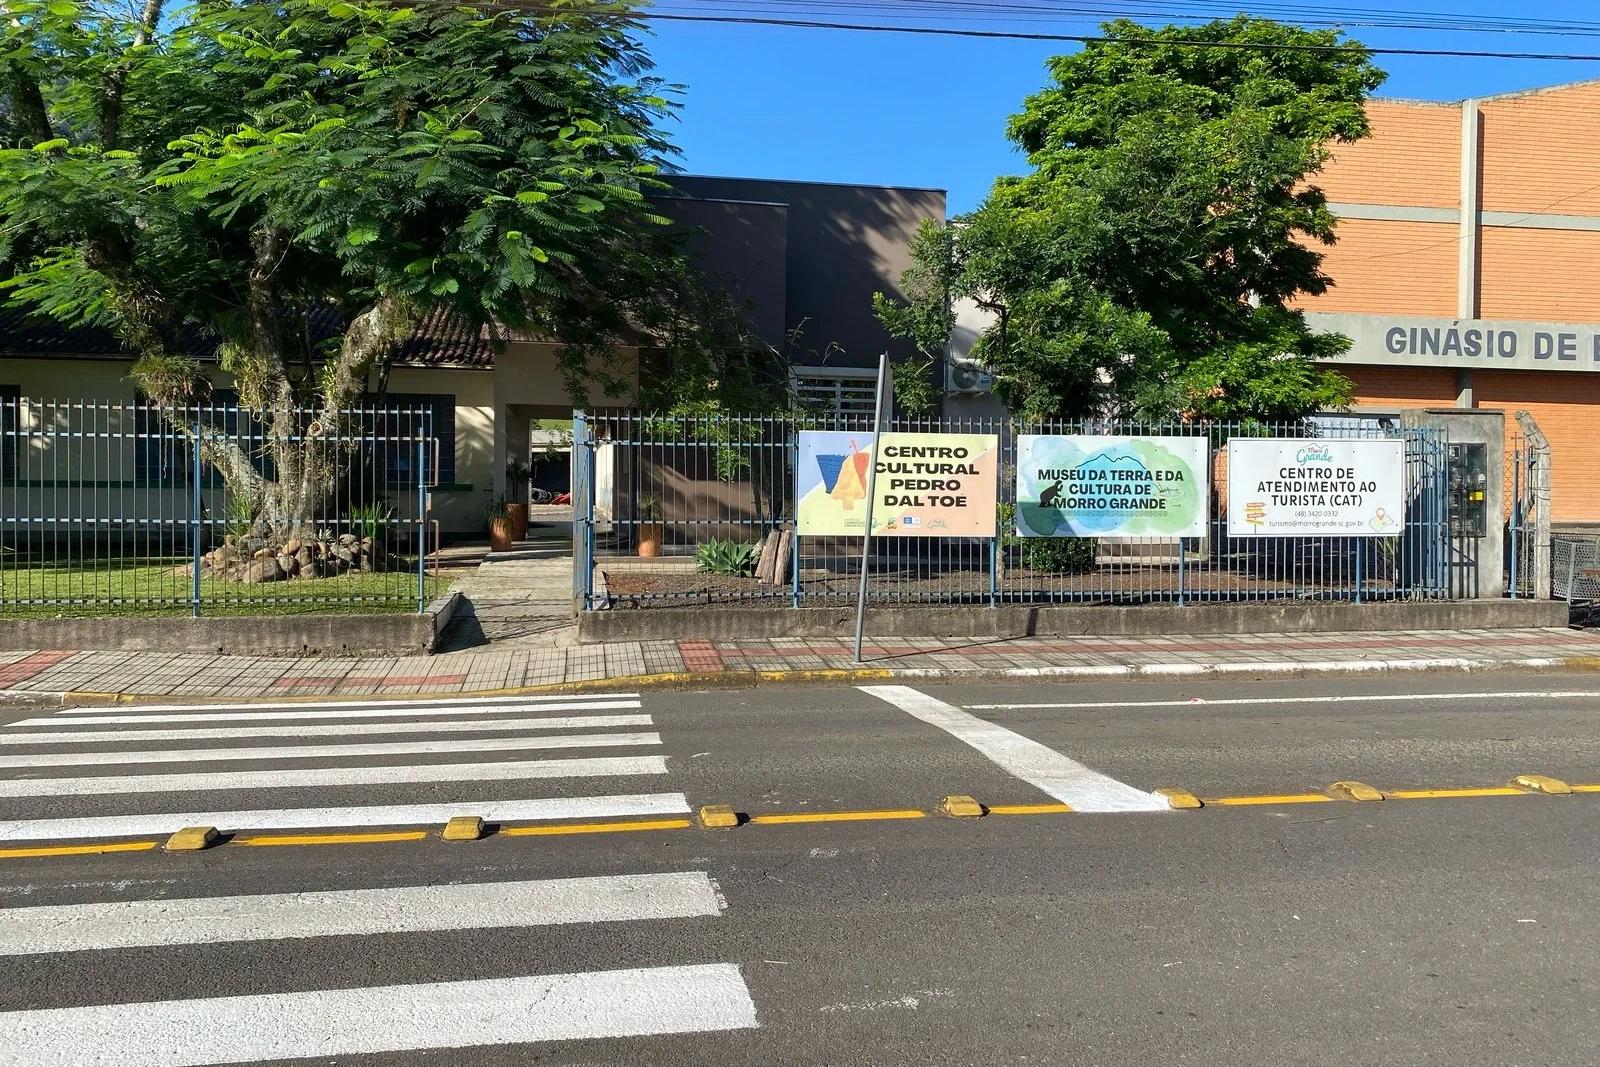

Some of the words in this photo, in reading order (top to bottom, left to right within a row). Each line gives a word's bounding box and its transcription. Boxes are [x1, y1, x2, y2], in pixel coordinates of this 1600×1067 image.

[1385, 320, 1518, 358] GINÁSIO
[1534, 332, 1577, 361] DE
[884, 446, 969, 459] CENTRO
[1296, 447, 1333, 466] Grande
[875, 462, 980, 475] CULTURAL
[1279, 467, 1333, 479] CENTRO
[1336, 468, 1355, 479] DE
[1038, 469, 1087, 481] MUSEU
[1088, 469, 1108, 481] DA
[1110, 469, 1153, 481] TERRA
[1155, 470, 1163, 481] E
[1165, 470, 1184, 481] DA
[890, 479, 961, 491] PEDRO
[1069, 483, 1133, 495] CULTURA
[1135, 484, 1151, 495] DE
[1257, 481, 1356, 493] ATENDIMENTO
[1359, 481, 1377, 493] AO
[884, 495, 925, 507] DAL
[1053, 497, 1108, 510] MORRO
[1110, 498, 1166, 510] GRANDE
[1271, 495, 1326, 506] TURISTA
[1330, 495, 1363, 507] (CAT)
[1295, 510, 1307, 518] (48)
